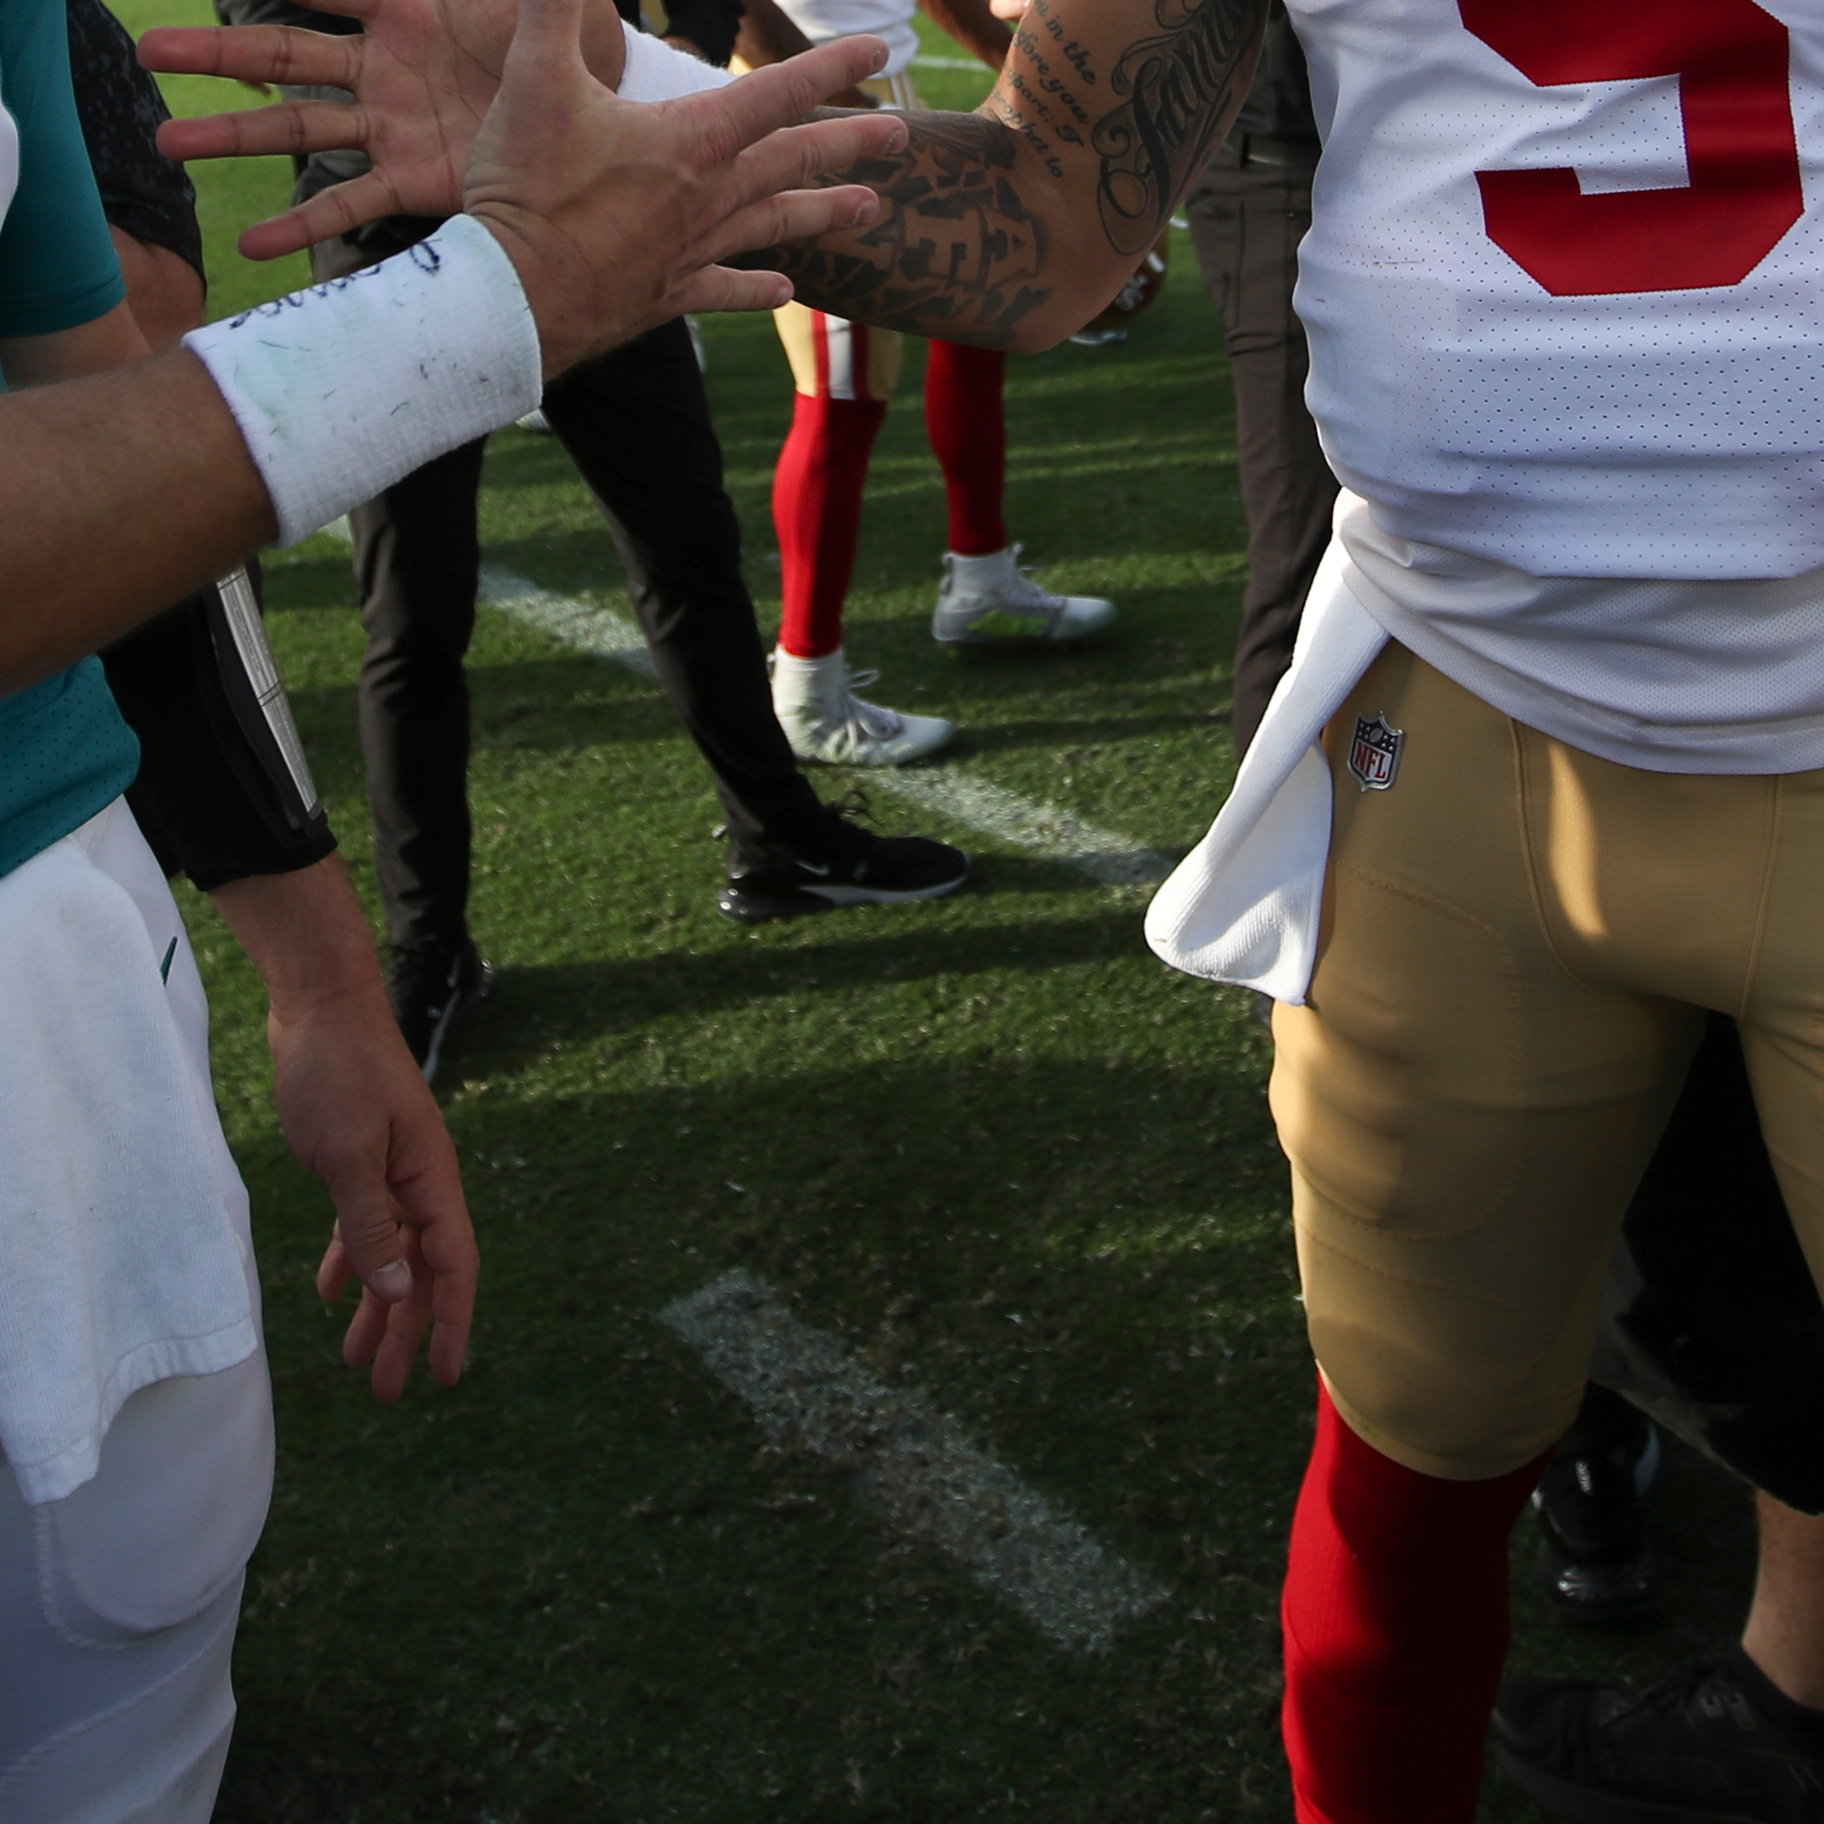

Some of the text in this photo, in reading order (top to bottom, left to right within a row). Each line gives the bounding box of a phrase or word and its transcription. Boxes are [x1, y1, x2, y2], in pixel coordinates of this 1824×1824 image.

[1063, 41, 1097, 85] the
[1039, 76, 1089, 125] you
[1353, 740, 1388, 780] NFL
